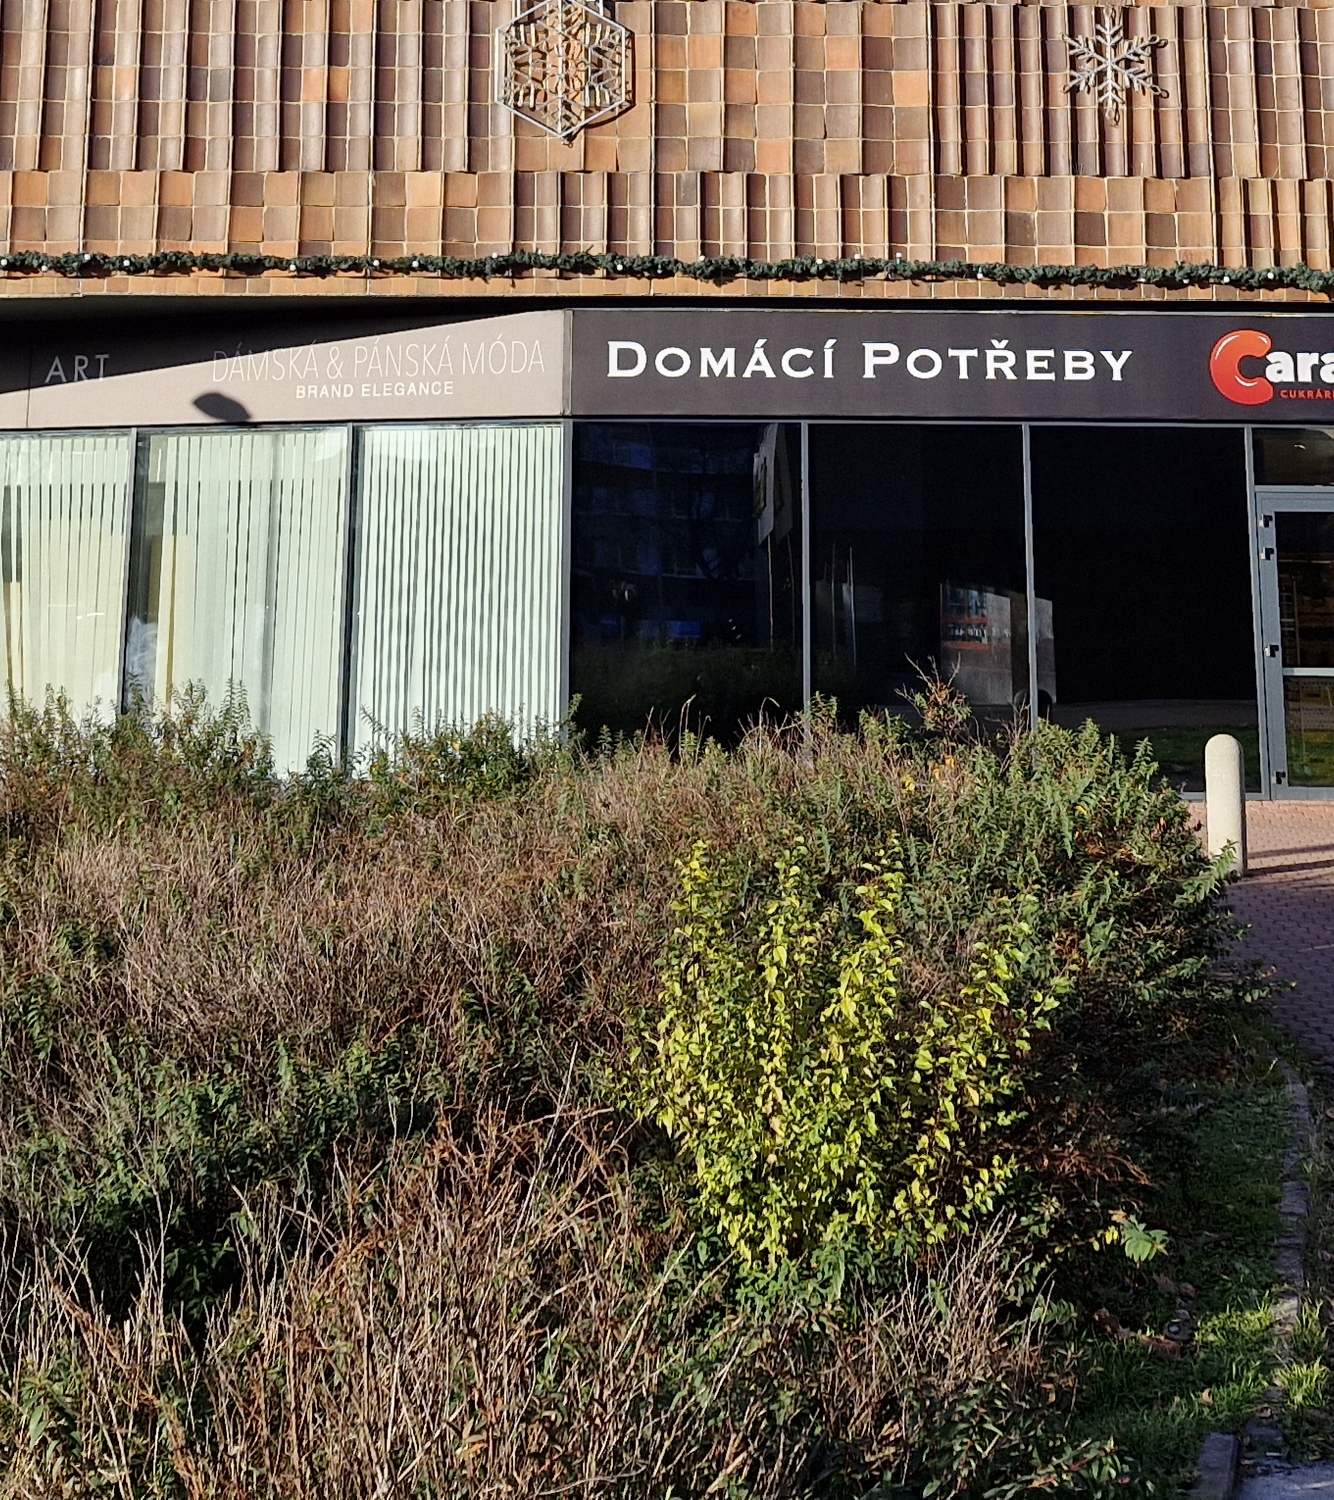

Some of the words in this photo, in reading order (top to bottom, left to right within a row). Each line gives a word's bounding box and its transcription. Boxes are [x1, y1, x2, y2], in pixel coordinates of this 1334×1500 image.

[44, 354, 110, 383] ART
[212, 340, 319, 382] DÁMSKÁ
[326, 346, 344, 379] &
[354, 335, 454, 378] PÁNSKÁ
[462, 333, 545, 376] MÓDA
[607, 339, 839, 378] DOMÁCÍ
[862, 339, 1134, 382] POTŘEBY
[296, 384, 354, 399] BRAND
[361, 381, 454, 397] ELEGANCE
